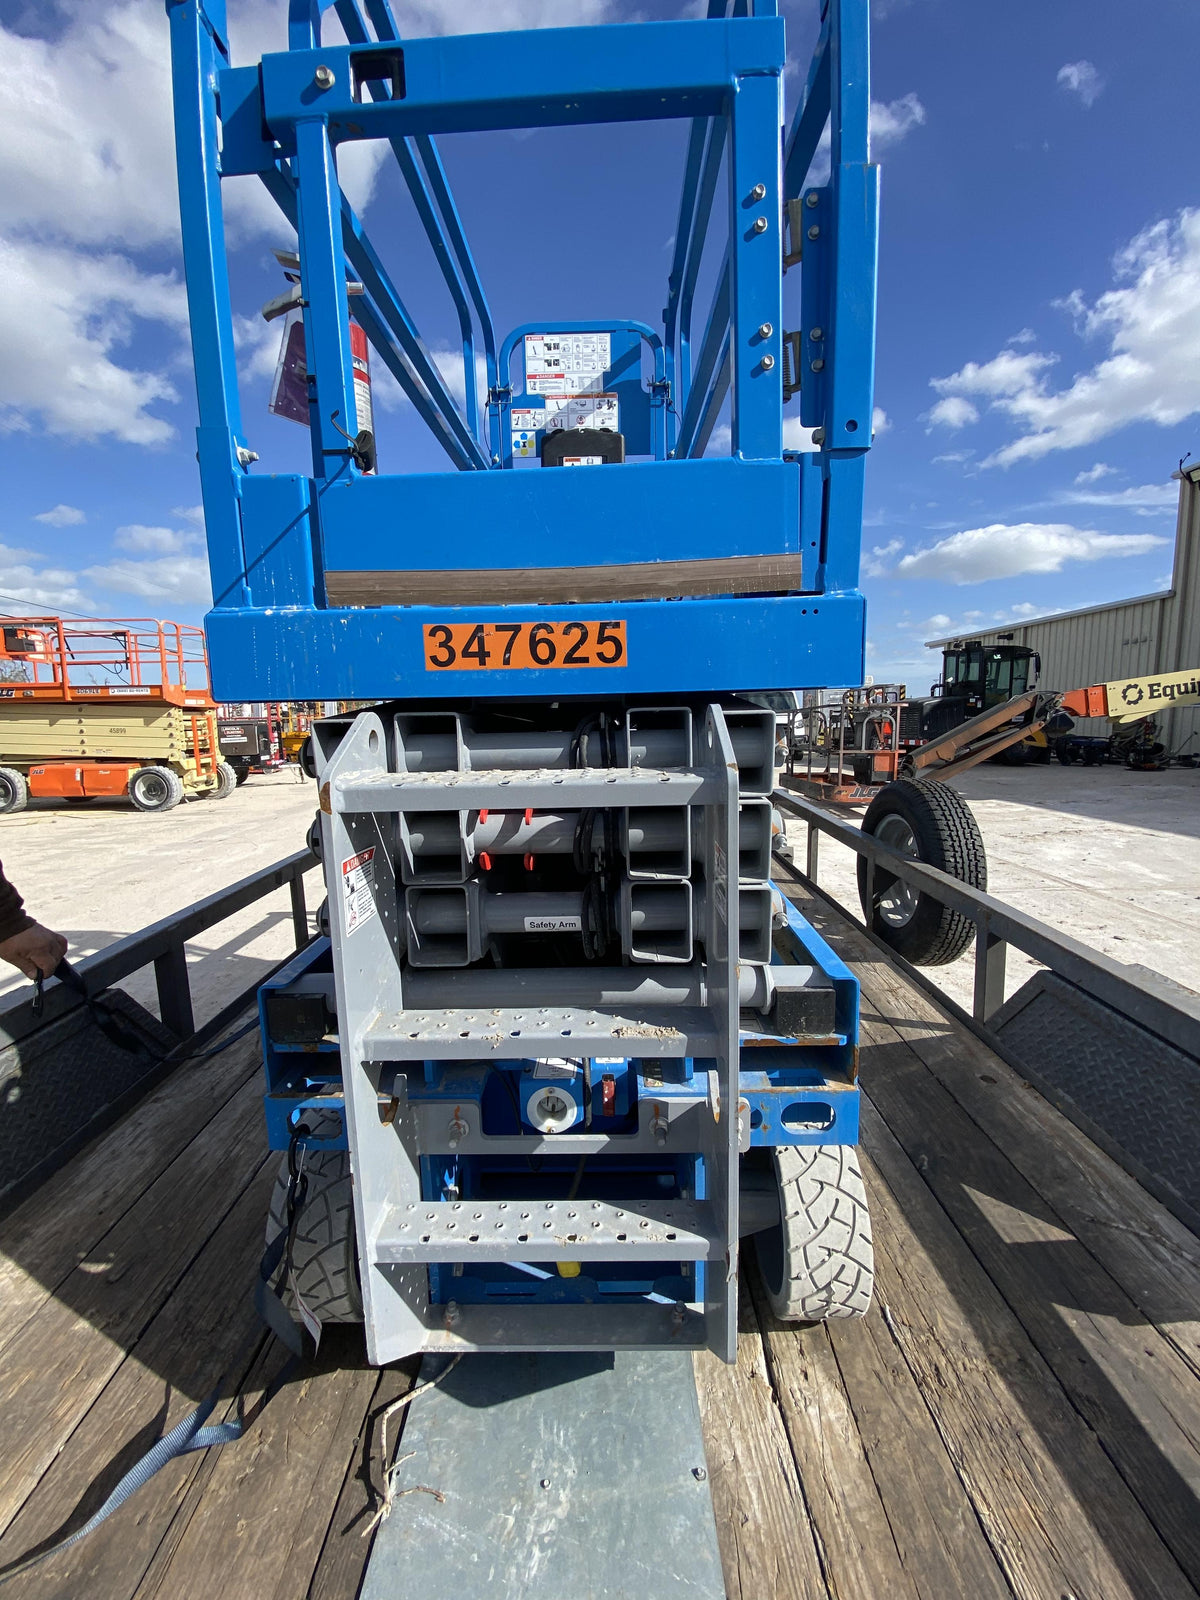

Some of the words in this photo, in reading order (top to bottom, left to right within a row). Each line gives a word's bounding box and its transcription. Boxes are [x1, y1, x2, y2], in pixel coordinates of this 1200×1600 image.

[428, 621, 623, 668] 347625
[1147, 678, 1200, 700] Equi
[529, 921, 556, 929] Safety
